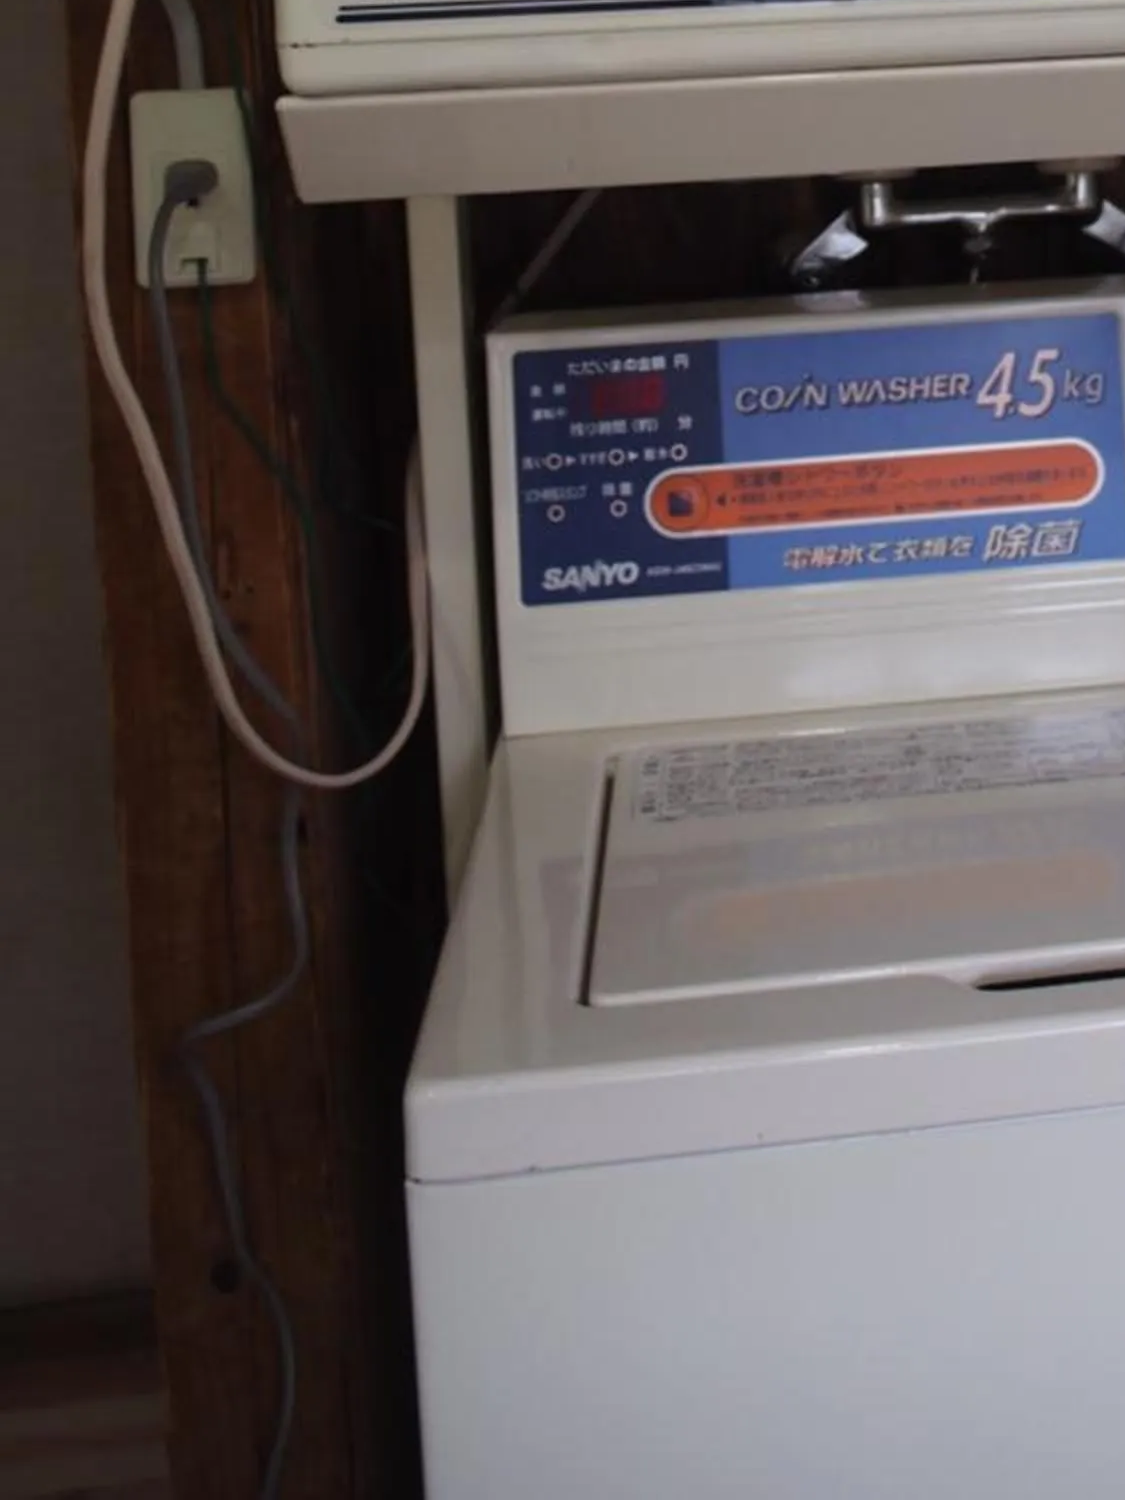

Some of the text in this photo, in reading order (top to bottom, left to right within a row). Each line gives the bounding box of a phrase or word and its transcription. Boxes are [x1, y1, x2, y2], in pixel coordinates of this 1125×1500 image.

[673, 353, 690, 371] 円
[733, 373, 831, 417] COIN
[837, 371, 974, 405] WASHER
[541, 559, 640, 593] SANYO
